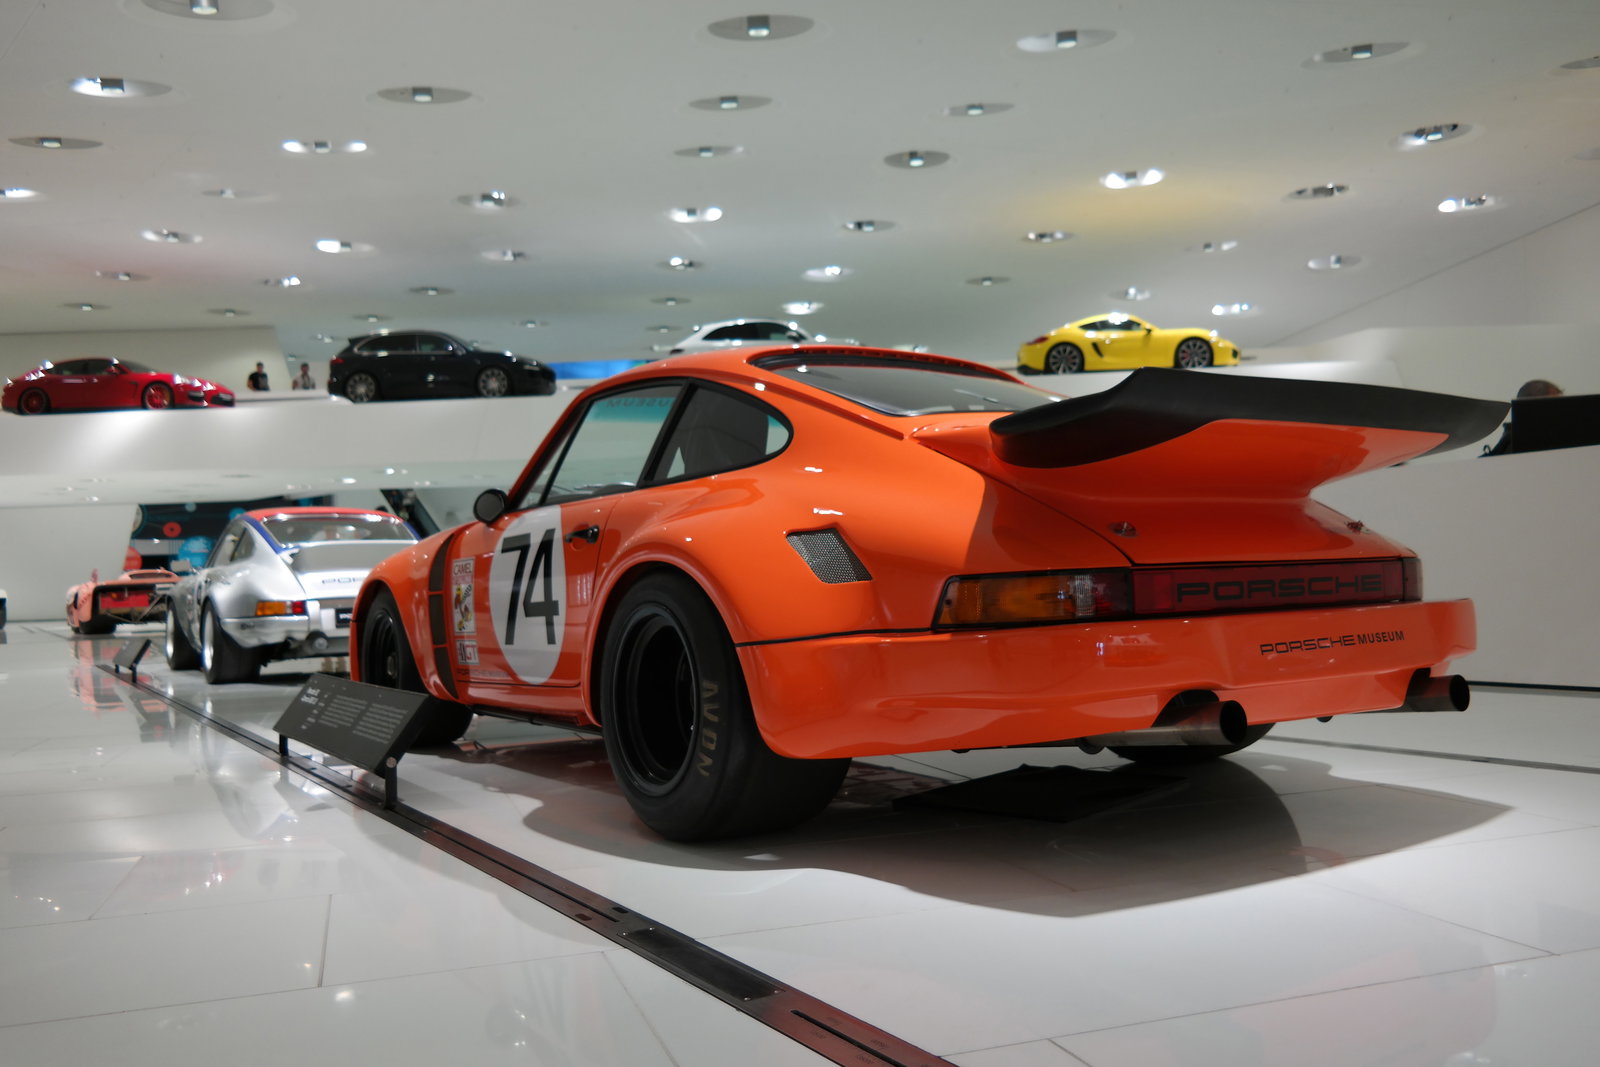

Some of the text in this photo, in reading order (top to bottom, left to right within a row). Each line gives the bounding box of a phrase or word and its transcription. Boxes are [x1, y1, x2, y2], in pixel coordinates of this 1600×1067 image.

[454, 562, 473, 575] CAMEL
[501, 528, 560, 646] 74
[1177, 573, 1383, 603] PORSCHE
[1260, 630, 1405, 656] PORSCHE MUSEUM
[697, 679, 720, 777] AVON
